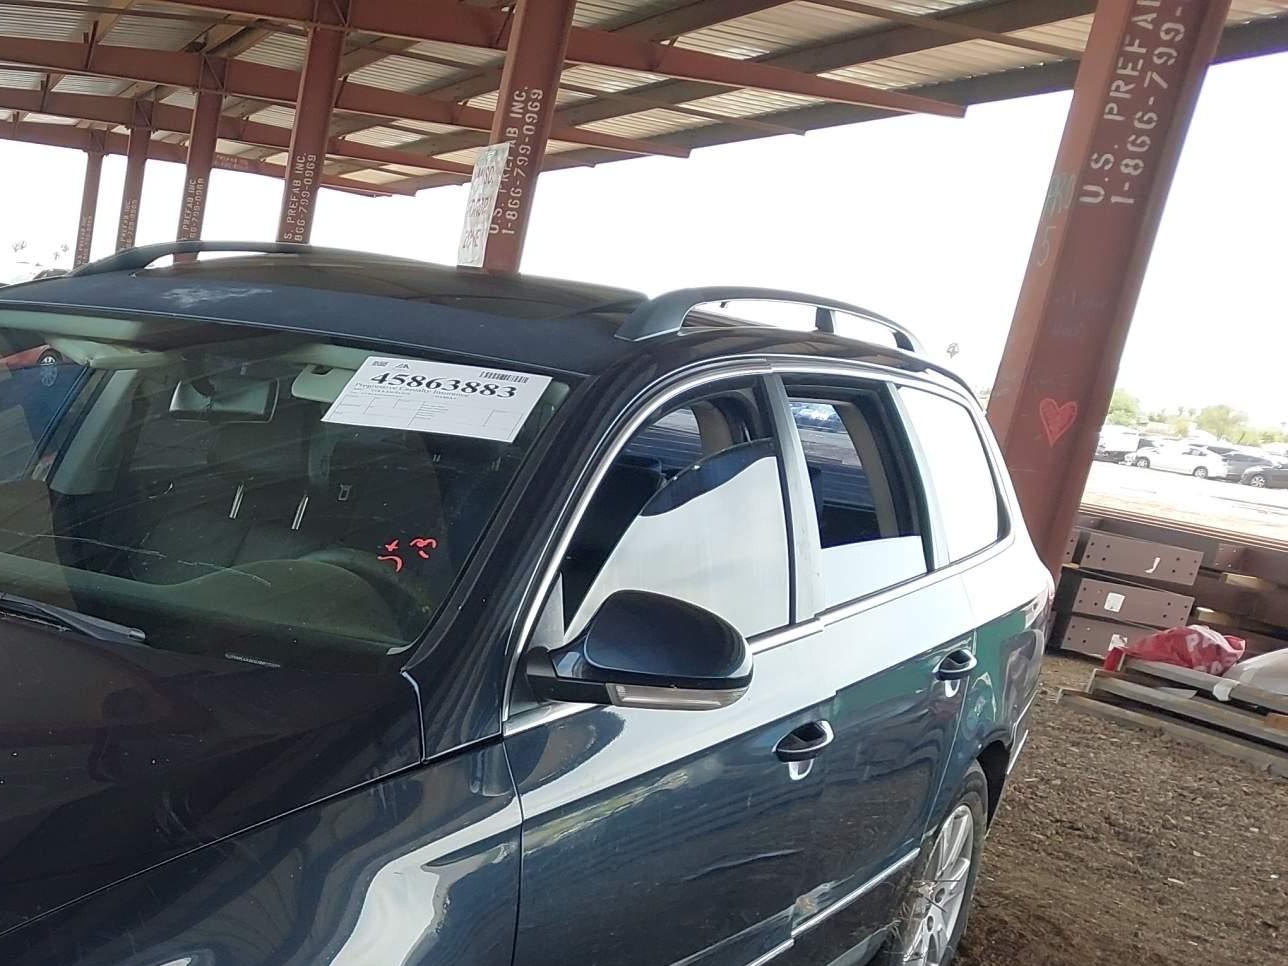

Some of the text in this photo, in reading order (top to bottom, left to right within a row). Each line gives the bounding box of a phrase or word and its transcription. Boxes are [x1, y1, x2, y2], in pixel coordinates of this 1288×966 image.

[510, 86, 528, 118] INC.
[1080, 0, 1161, 204] U.S. PREFA
[502, 89, 543, 234] 1-866-799-0969
[287, 179, 302, 223] PREFAB
[370, 372, 517, 399] 45863883
